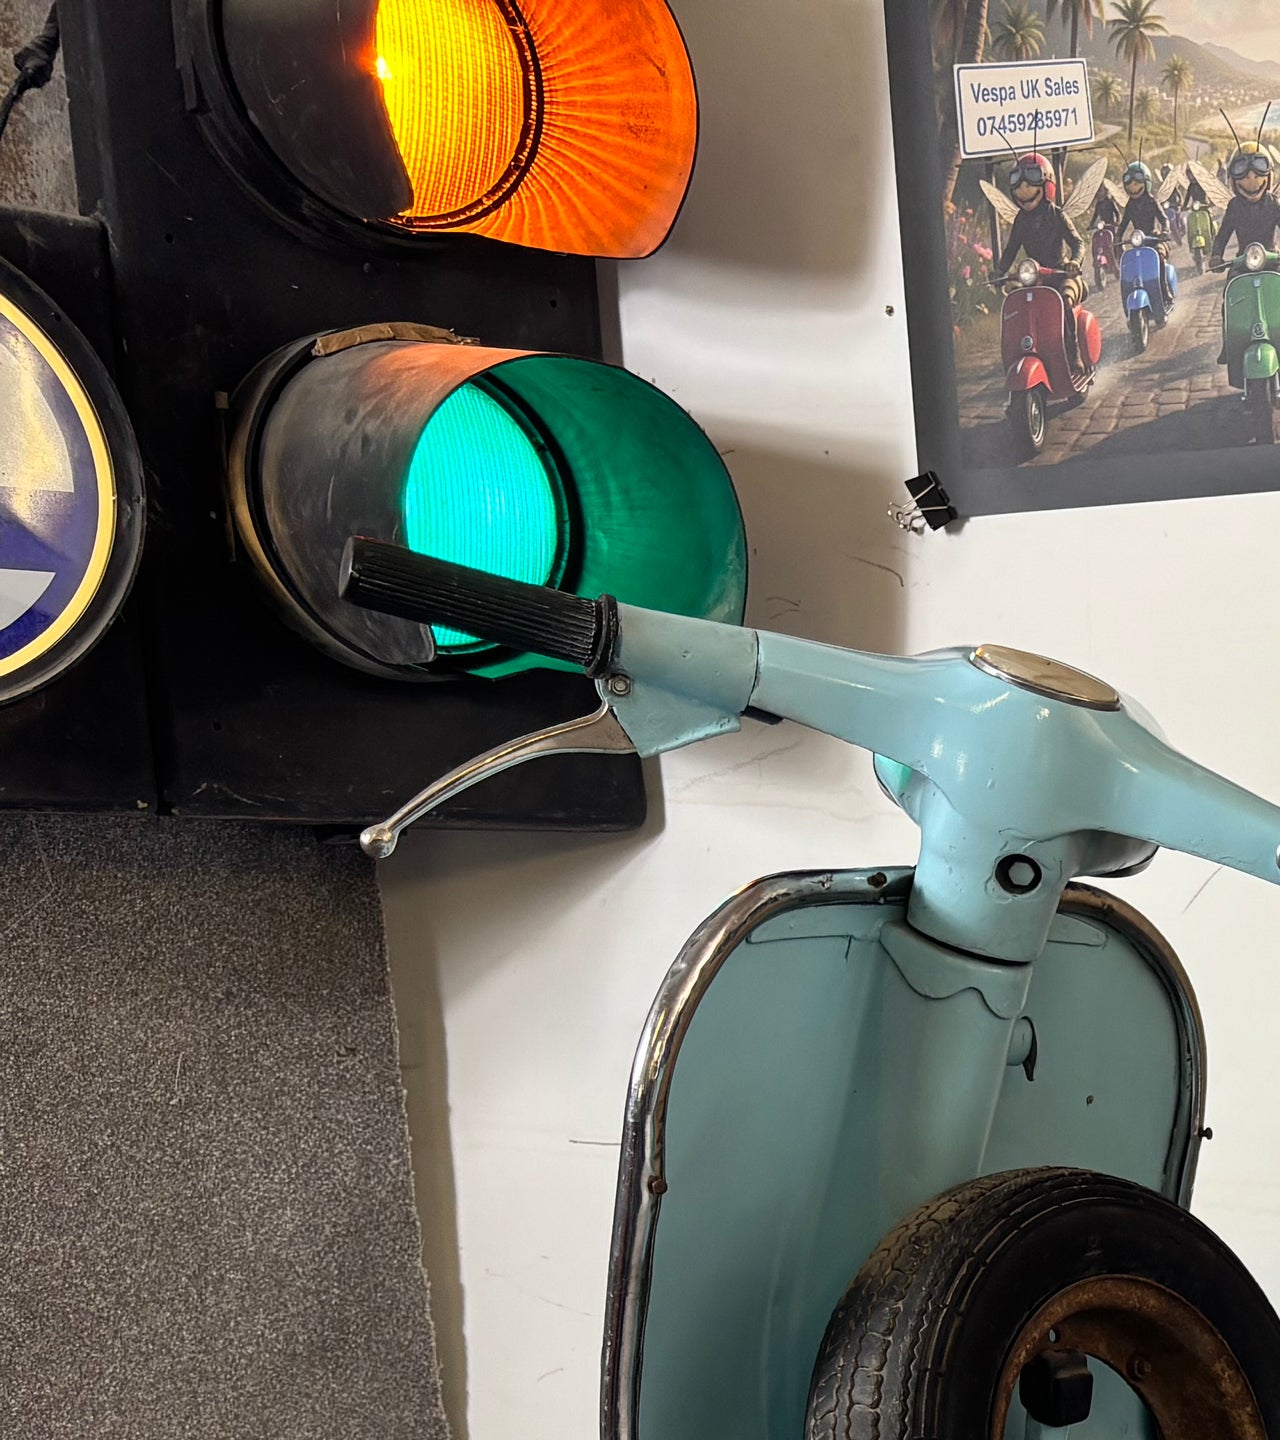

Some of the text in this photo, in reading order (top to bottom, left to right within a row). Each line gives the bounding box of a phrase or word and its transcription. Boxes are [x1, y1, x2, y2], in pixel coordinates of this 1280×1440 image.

[970, 76, 1080, 106] Vespa UK Sales
[976, 107, 1079, 137] 07459285971
